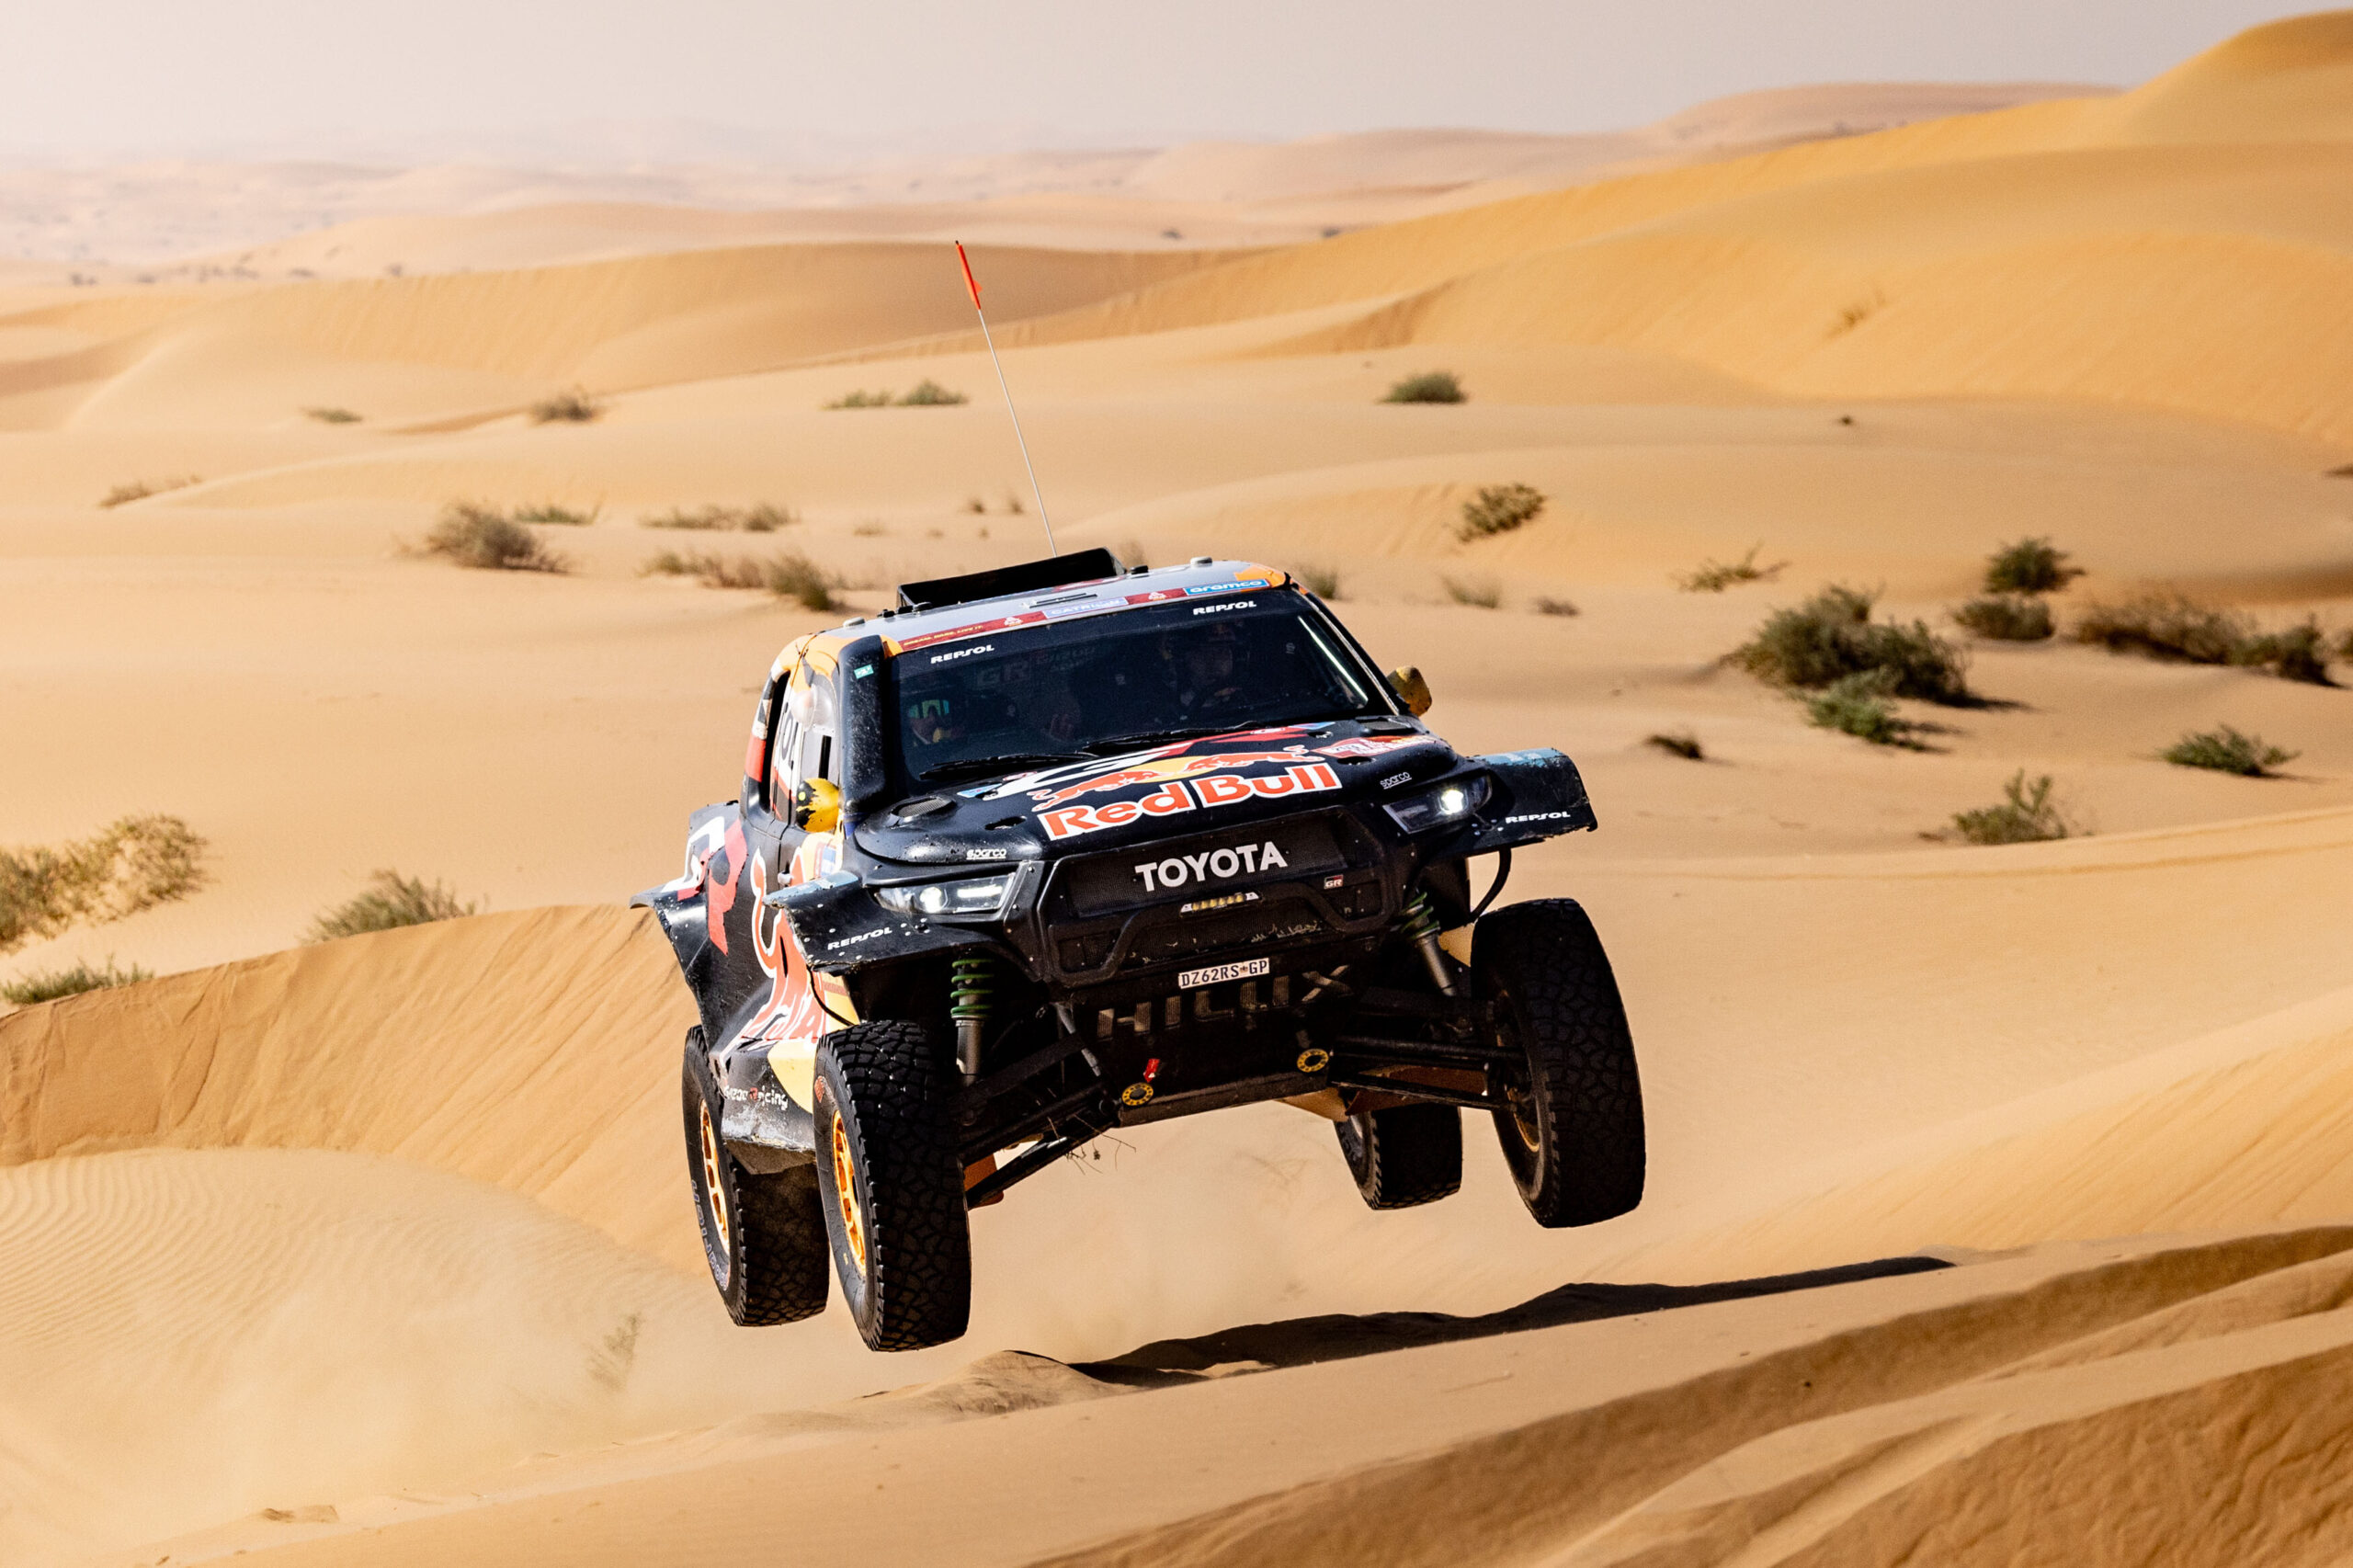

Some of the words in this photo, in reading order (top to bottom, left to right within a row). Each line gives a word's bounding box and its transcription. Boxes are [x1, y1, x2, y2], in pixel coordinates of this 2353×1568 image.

[1189, 581, 1262, 593] aramco
[1193, 600, 1257, 615] REPSOL
[930, 644, 995, 664] REPSOL
[1380, 771, 1413, 790] sparco
[1043, 783, 1192, 837] Red
[1194, 765, 1338, 806] Bull
[1506, 812, 1571, 824] REPSOL
[966, 848, 1007, 860] sparco
[1134, 841, 1288, 892] TOYOTA
[1324, 878, 1343, 889] GR
[827, 926, 892, 950] REPSOL
[1181, 965, 1239, 987] DZ62RS
[1249, 960, 1267, 974] GP
[1097, 964, 1352, 1040] HILUX
